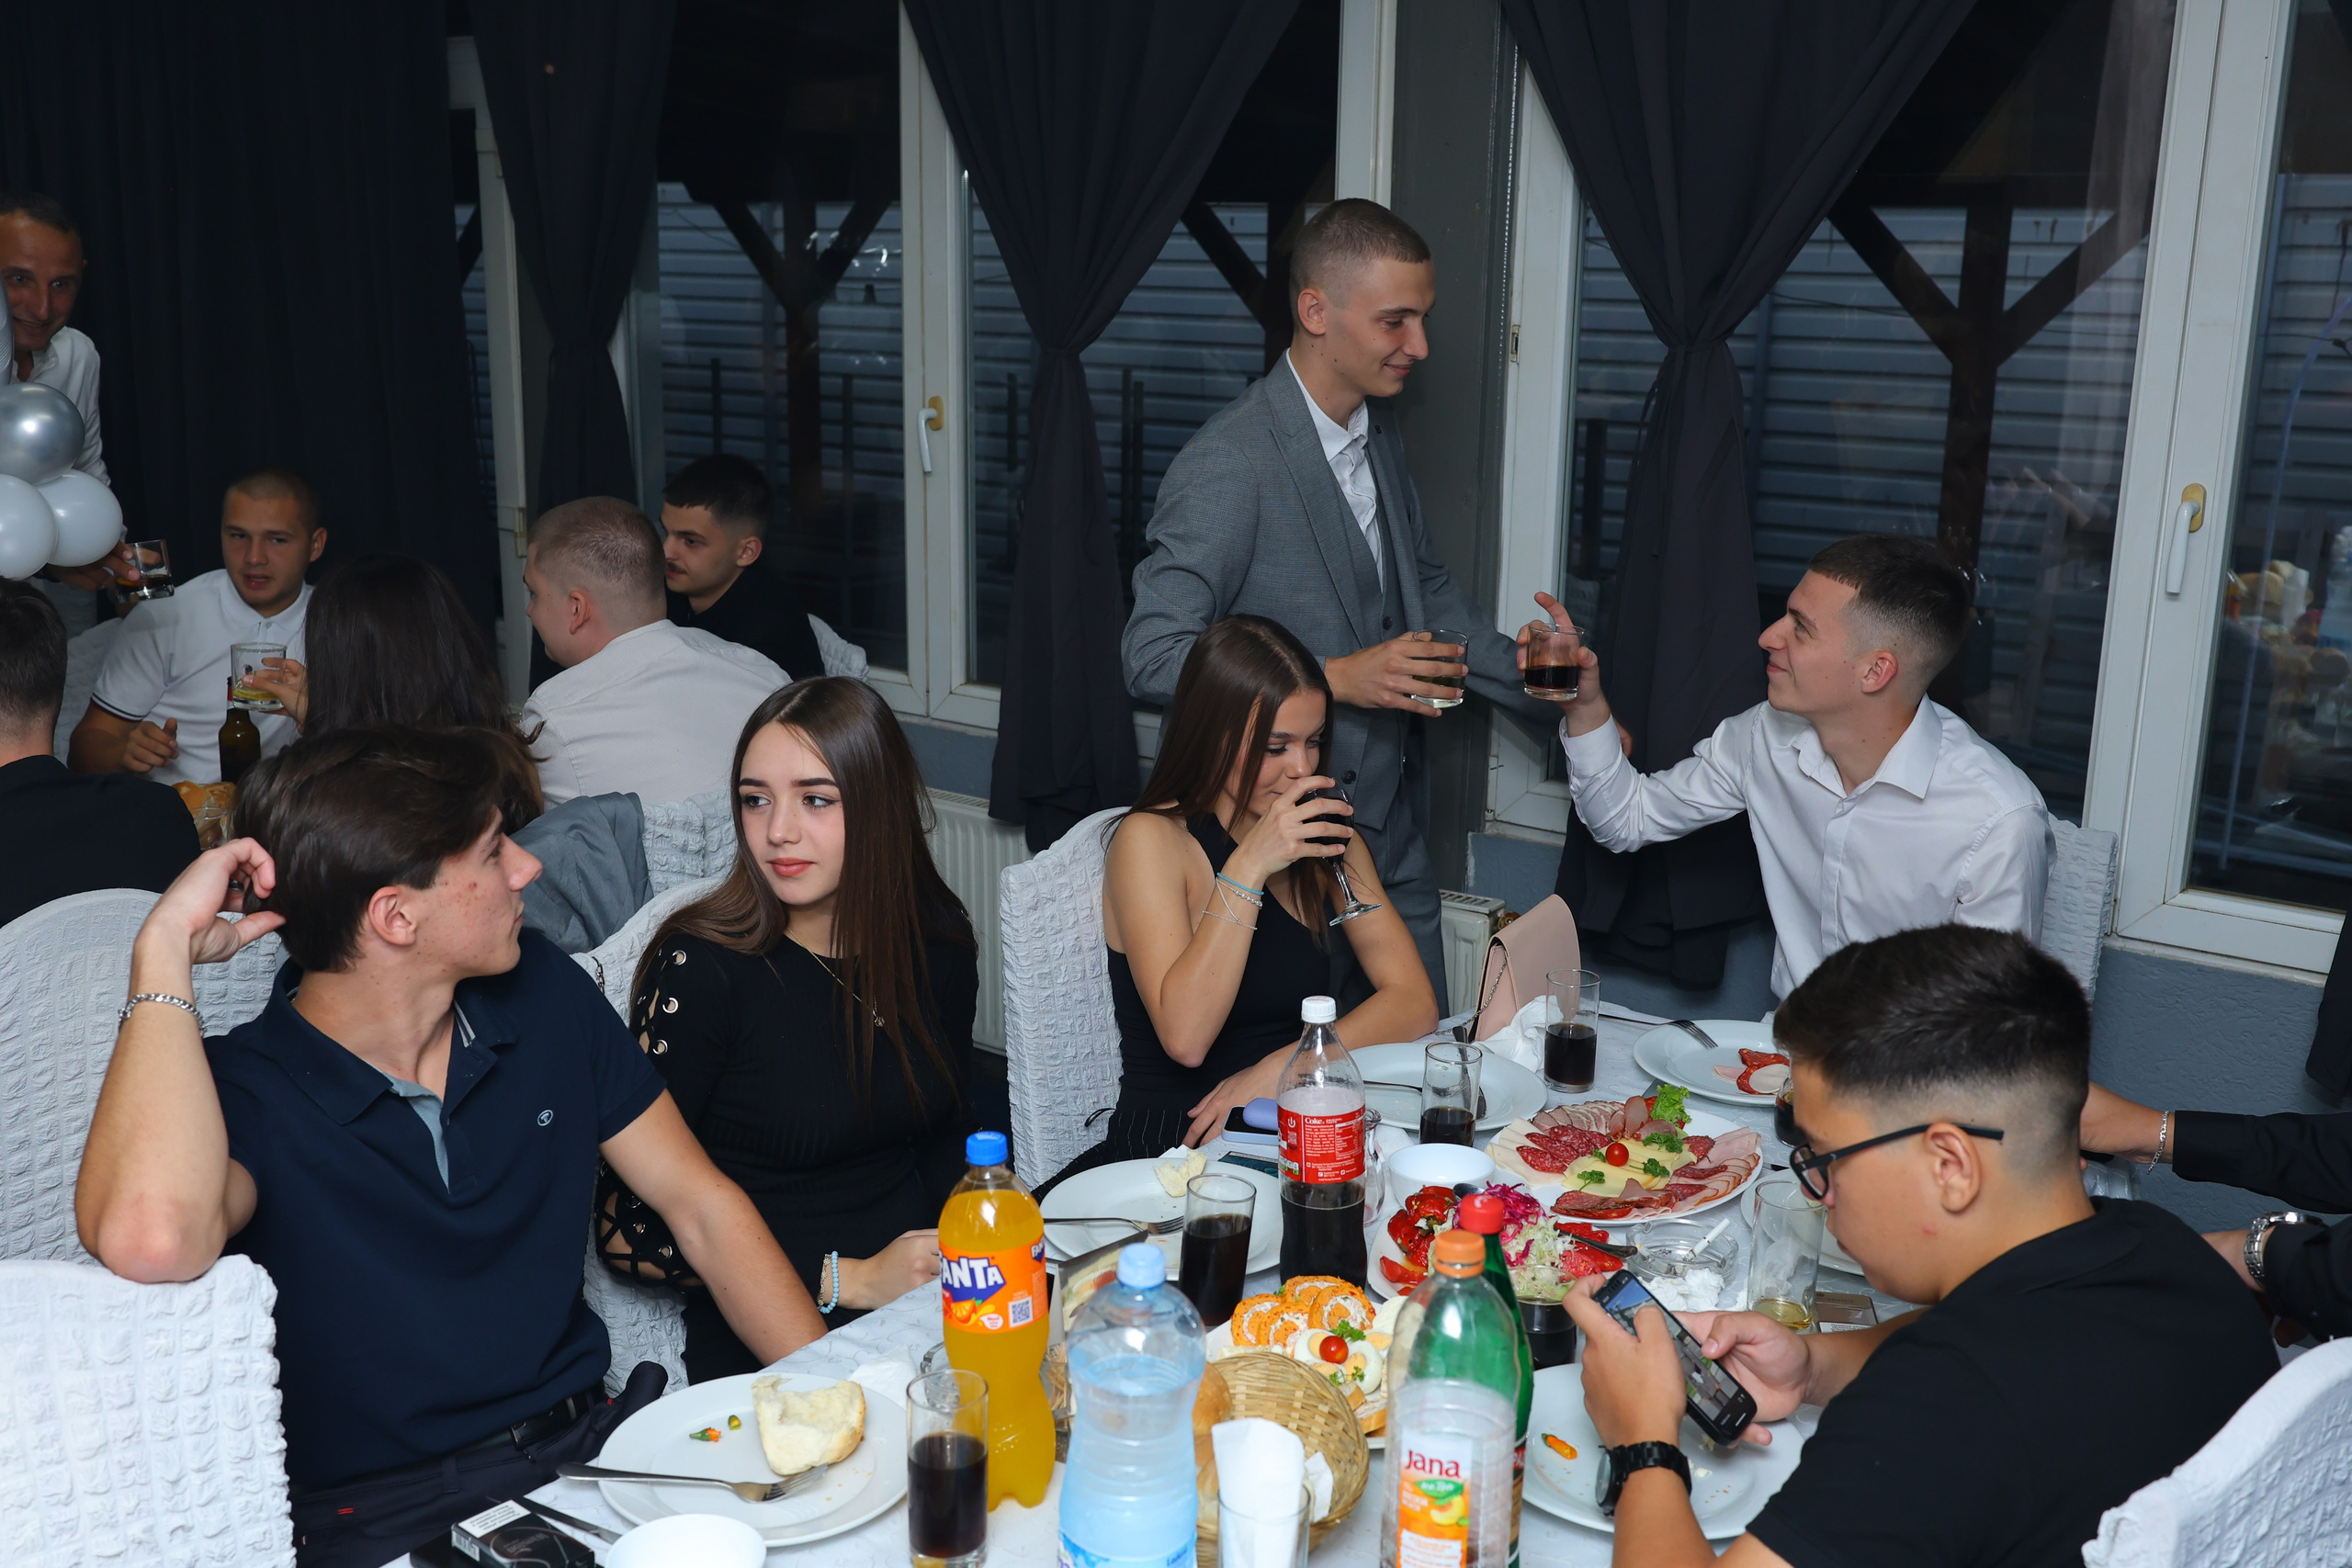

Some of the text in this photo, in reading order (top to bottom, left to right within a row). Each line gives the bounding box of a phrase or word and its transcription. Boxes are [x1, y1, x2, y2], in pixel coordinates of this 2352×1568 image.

[1031, 1242, 1045, 1258] FAN
[941, 1257, 1004, 1289] ANTA
[1405, 1450, 1461, 1478] Jana
